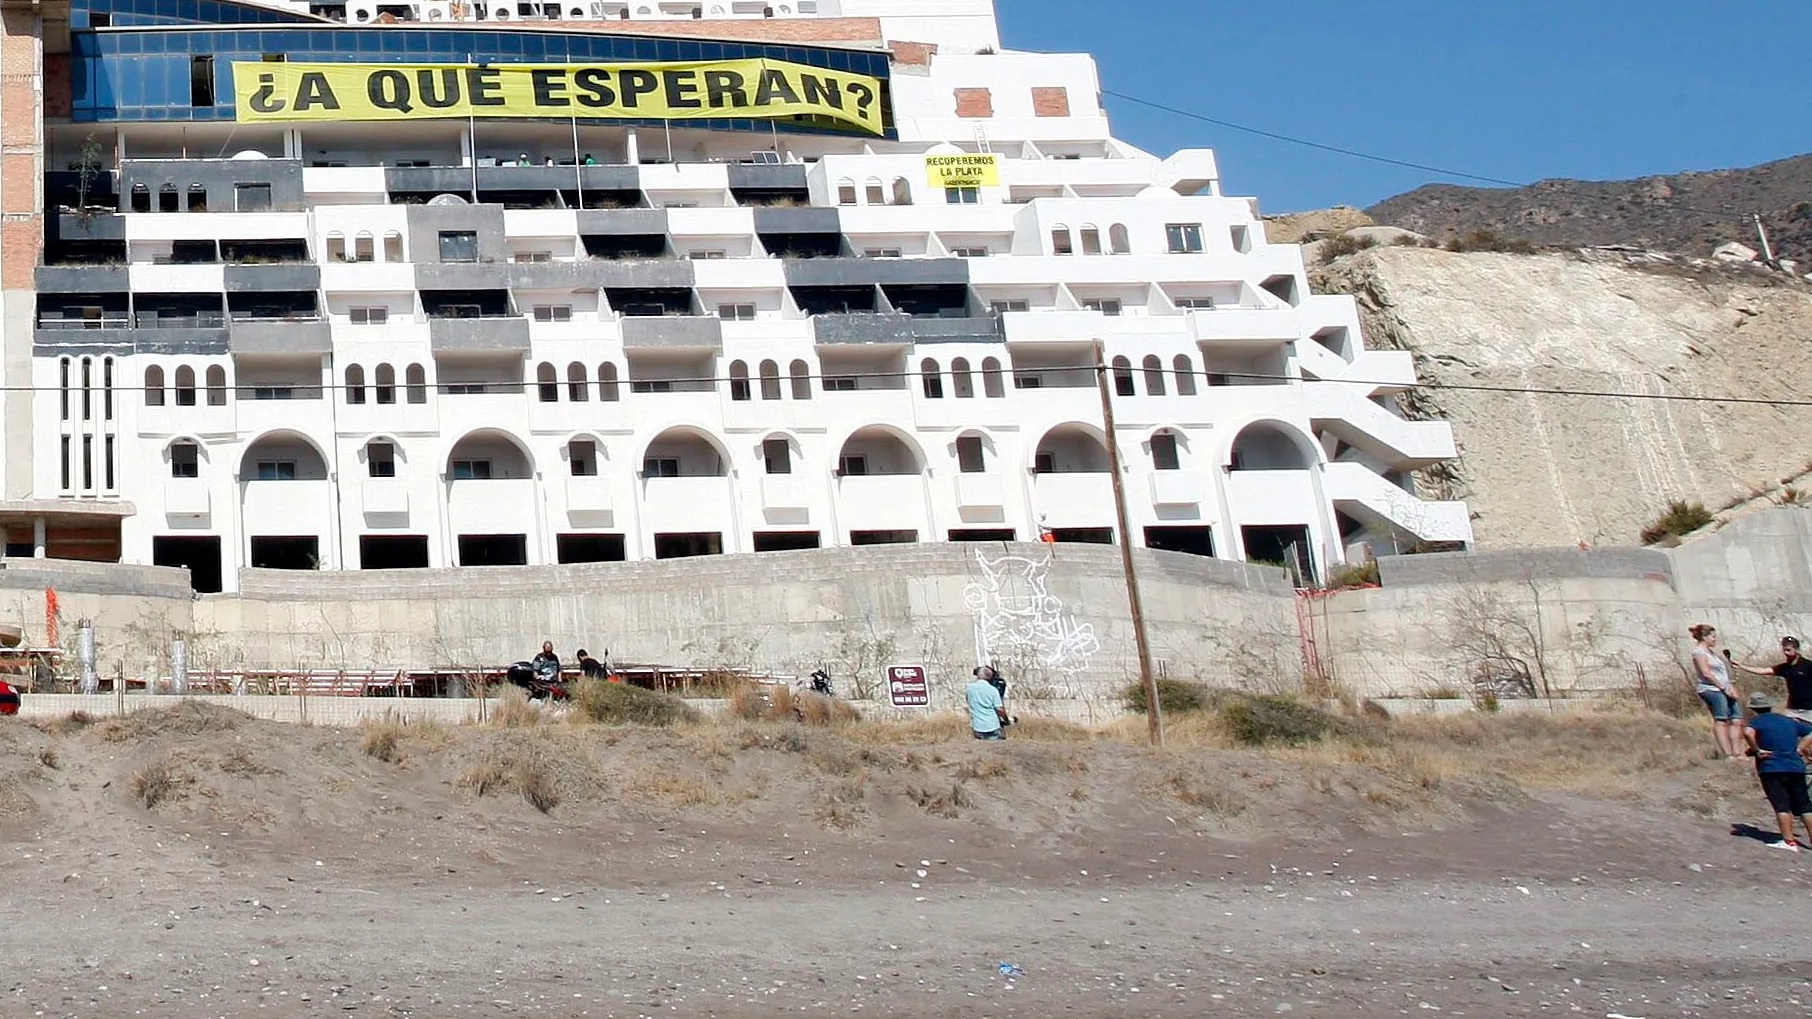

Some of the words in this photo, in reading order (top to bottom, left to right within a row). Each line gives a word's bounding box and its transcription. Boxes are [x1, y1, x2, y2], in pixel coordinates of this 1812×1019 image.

[249, 72, 340, 113] ¿A
[531, 67, 873, 120] ESPERAN?
[940, 167, 952, 176] LA
[955, 167, 984, 176] PLAYA
